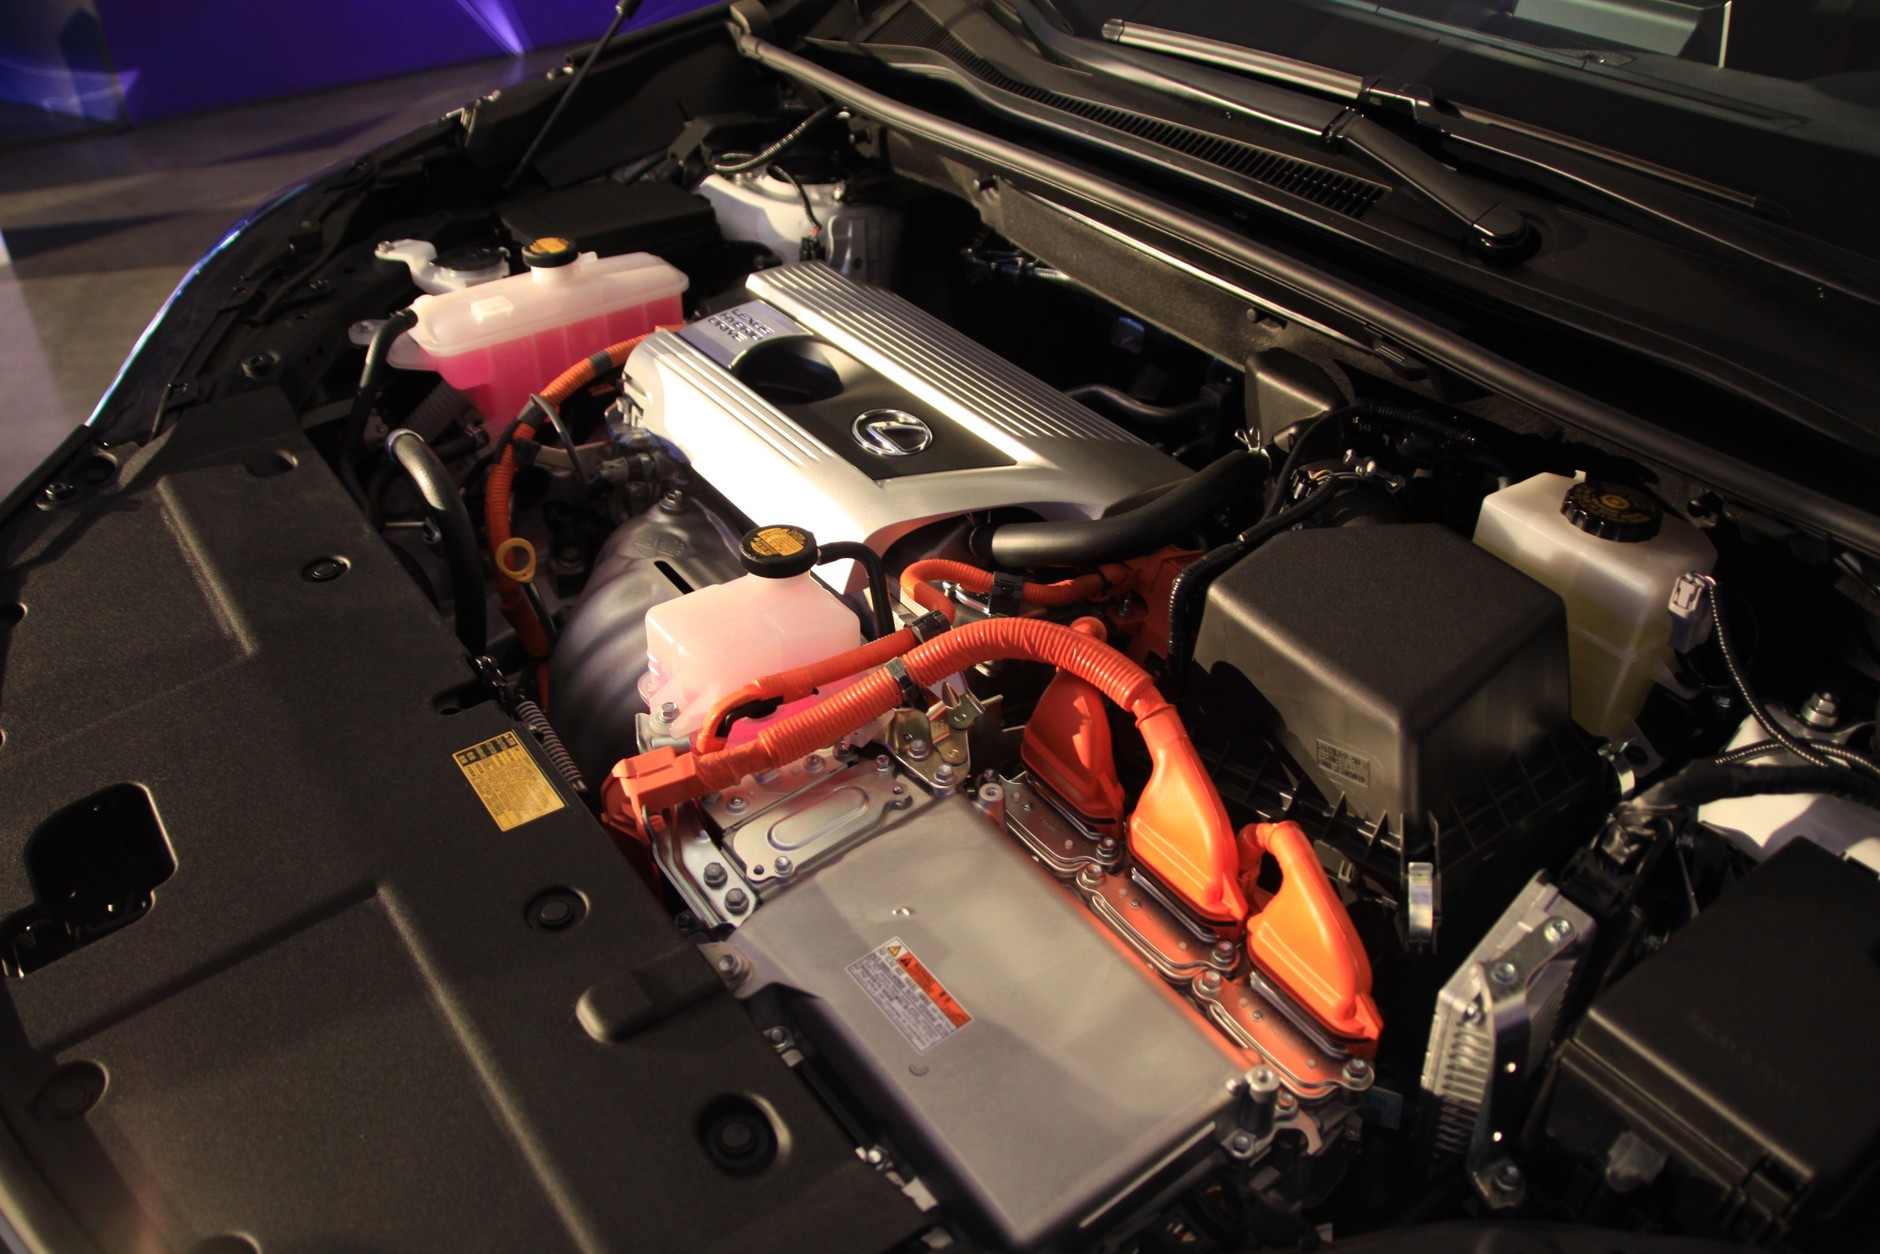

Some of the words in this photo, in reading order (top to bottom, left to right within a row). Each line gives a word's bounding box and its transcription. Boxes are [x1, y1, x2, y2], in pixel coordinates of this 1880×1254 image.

[708, 315, 748, 342] DRIVE
[720, 312, 764, 341] HYBRID
[732, 308, 776, 335] LEXUS
